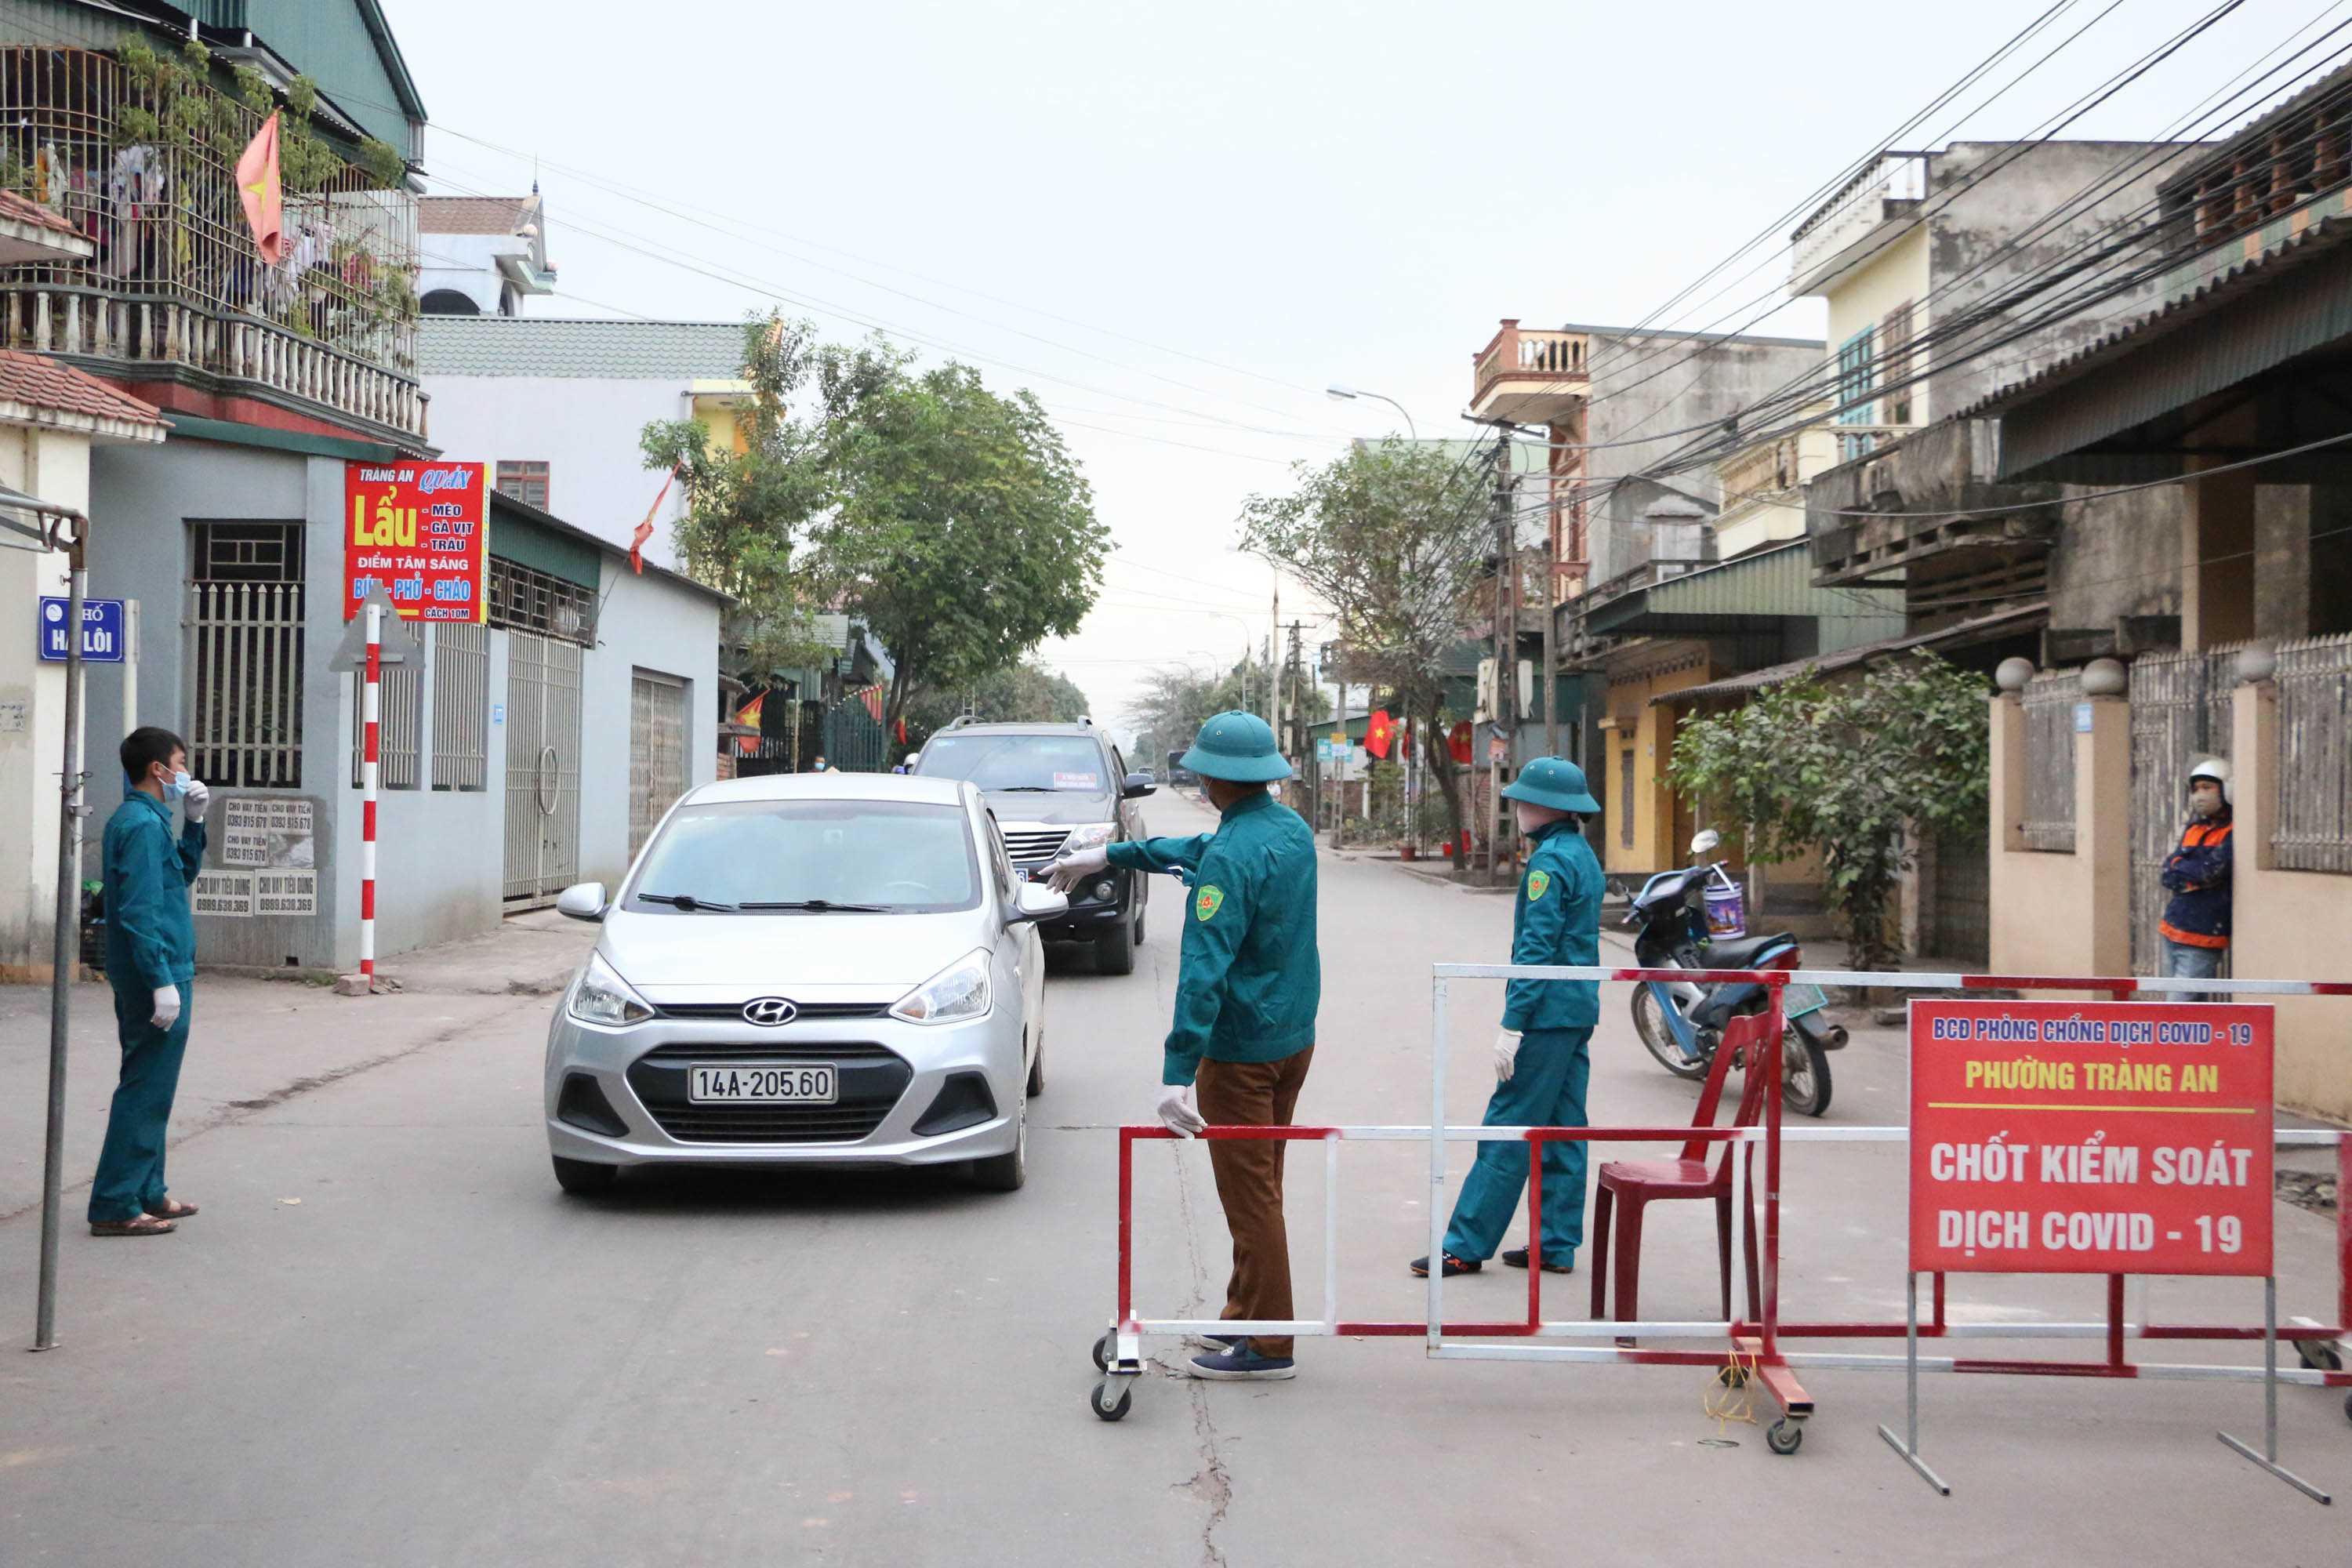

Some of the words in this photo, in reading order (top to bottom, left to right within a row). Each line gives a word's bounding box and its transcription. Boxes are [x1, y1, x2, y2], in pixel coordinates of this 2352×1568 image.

[360, 466, 395, 482] TRÀNG
[397, 469, 415, 482] AN
[354, 485, 417, 547] Lẩu
[431, 503, 462, 517] MÈO
[430, 520, 450, 534] GÀ
[452, 521, 474, 537] VỊT
[430, 537, 466, 551] TRÂU
[358, 551, 392, 568] ĐIỂM
[395, 556, 426, 569] TÂM
[430, 556, 468, 570] SÁNG
[354, 574, 383, 599] BÚ
[394, 571, 423, 600] PHỞ
[434, 576, 470, 601] CHÁO
[82, 604, 103, 621] HỐ
[424, 606, 449, 618] CÁCH
[451, 608, 469, 619] 10M
[83, 627, 112, 652] LÔI
[228, 802, 241, 811] CHO
[242, 804, 252, 812] VAY
[272, 804, 285, 813] CHO
[243, 815, 255, 828] 915
[287, 817, 298, 829] 915
[227, 836, 239, 844] CHO
[242, 849, 254, 860] 915
[197, 877, 208, 894] CHO
[260, 877, 270, 895] CHO
[1933, 1017, 1971, 1040] BCĐ
[1975, 1014, 2038, 1042] PHÒNG
[2042, 1013, 2104, 1043] CHỐNG
[2109, 1020, 2153, 1048] DỊCH
[2158, 1022, 2211, 1044] COVID
[2229, 1023, 2252, 1046] 19
[1965, 1054, 2075, 1090] PHƯỜNG
[2083, 1058, 2173, 1092] TRÀNG
[2180, 1065, 2218, 1092] AN
[699, 1071, 829, 1097] 14A-205.60
[1930, 1130, 2029, 1182] CHỐT
[2041, 1130, 2139, 1184] KIỂM
[2151, 1140, 2252, 1186] SOÁT
[1938, 1210, 2029, 1257] DỊCH
[2042, 1212, 2154, 1251] COVID
[2195, 1216, 2242, 1254] 19
